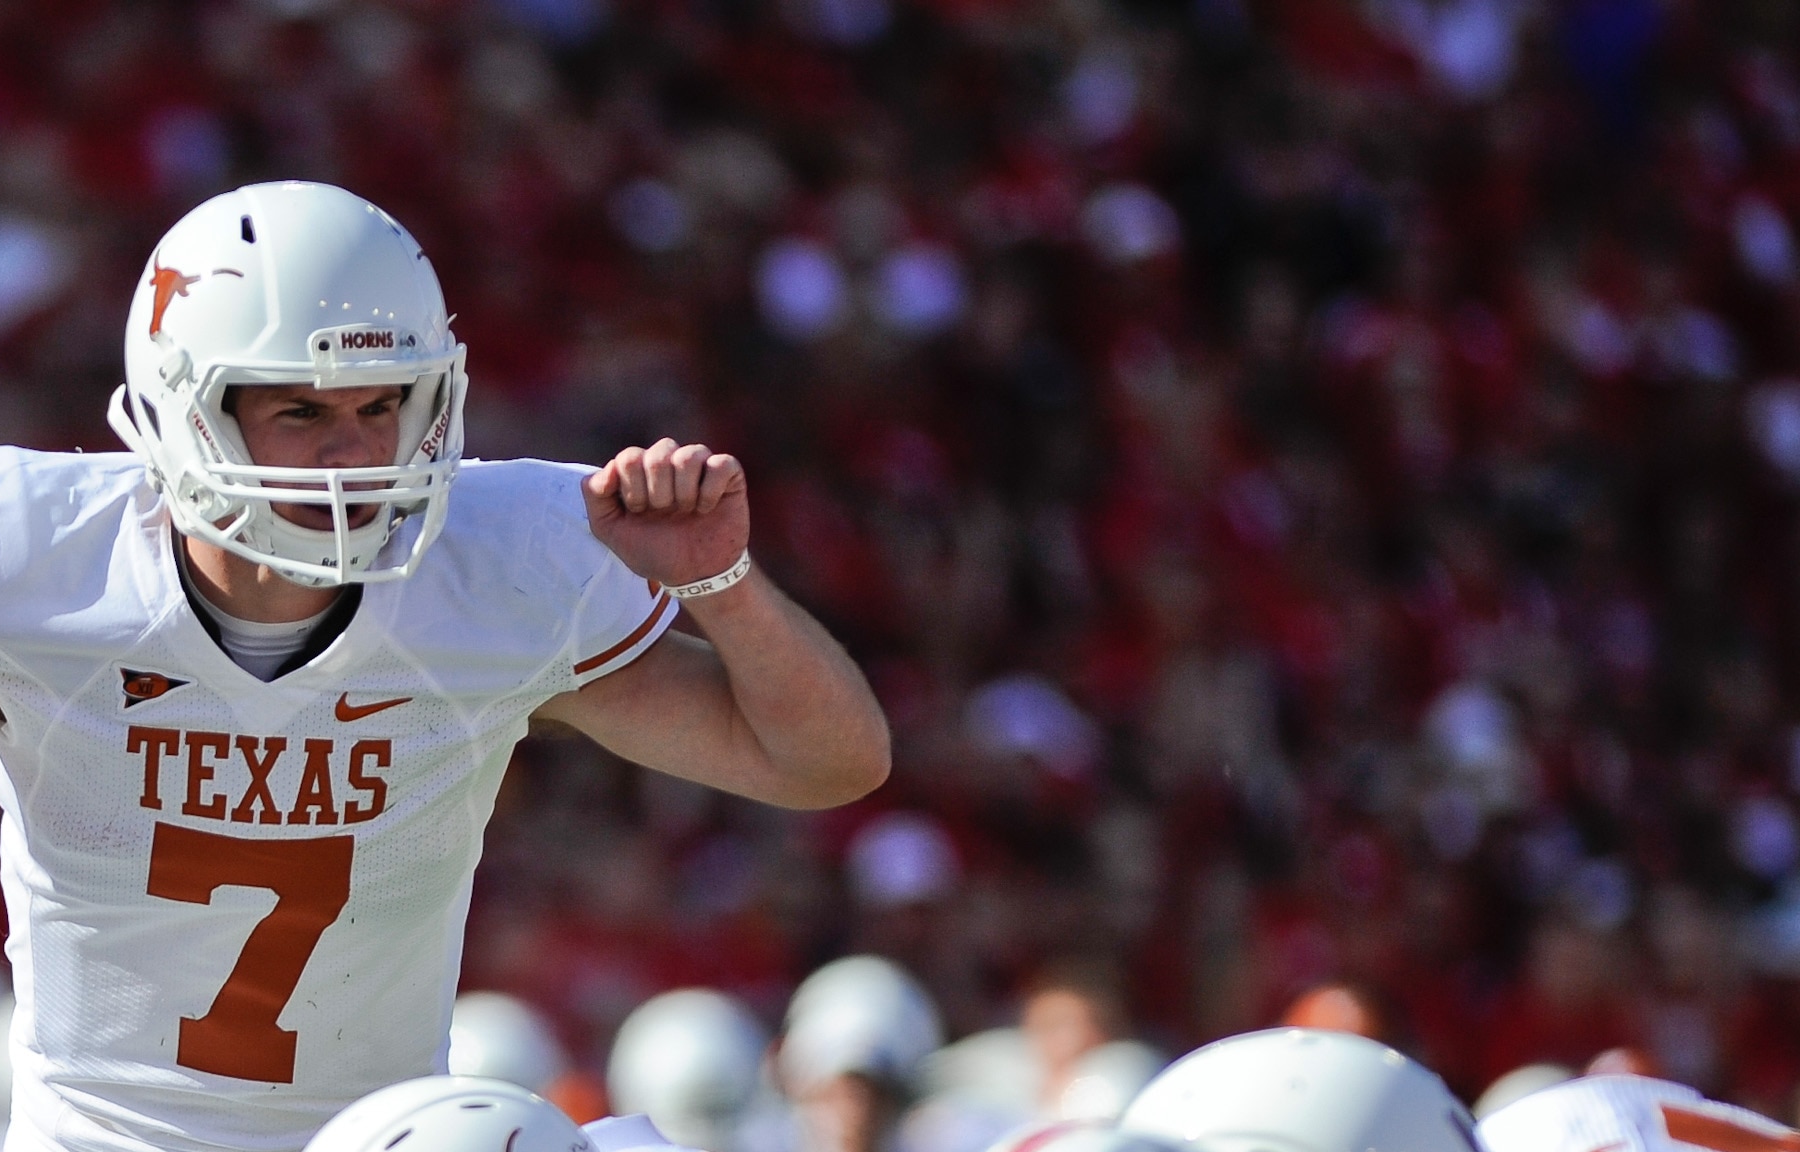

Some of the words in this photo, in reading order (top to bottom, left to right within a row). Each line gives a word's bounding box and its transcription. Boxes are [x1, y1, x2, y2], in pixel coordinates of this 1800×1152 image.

[341, 331, 394, 349] HORNS
[420, 405, 451, 457] Ridd
[677, 581, 714, 597] FOR
[126, 725, 392, 825] TEXAS
[146, 821, 355, 1084] 7
